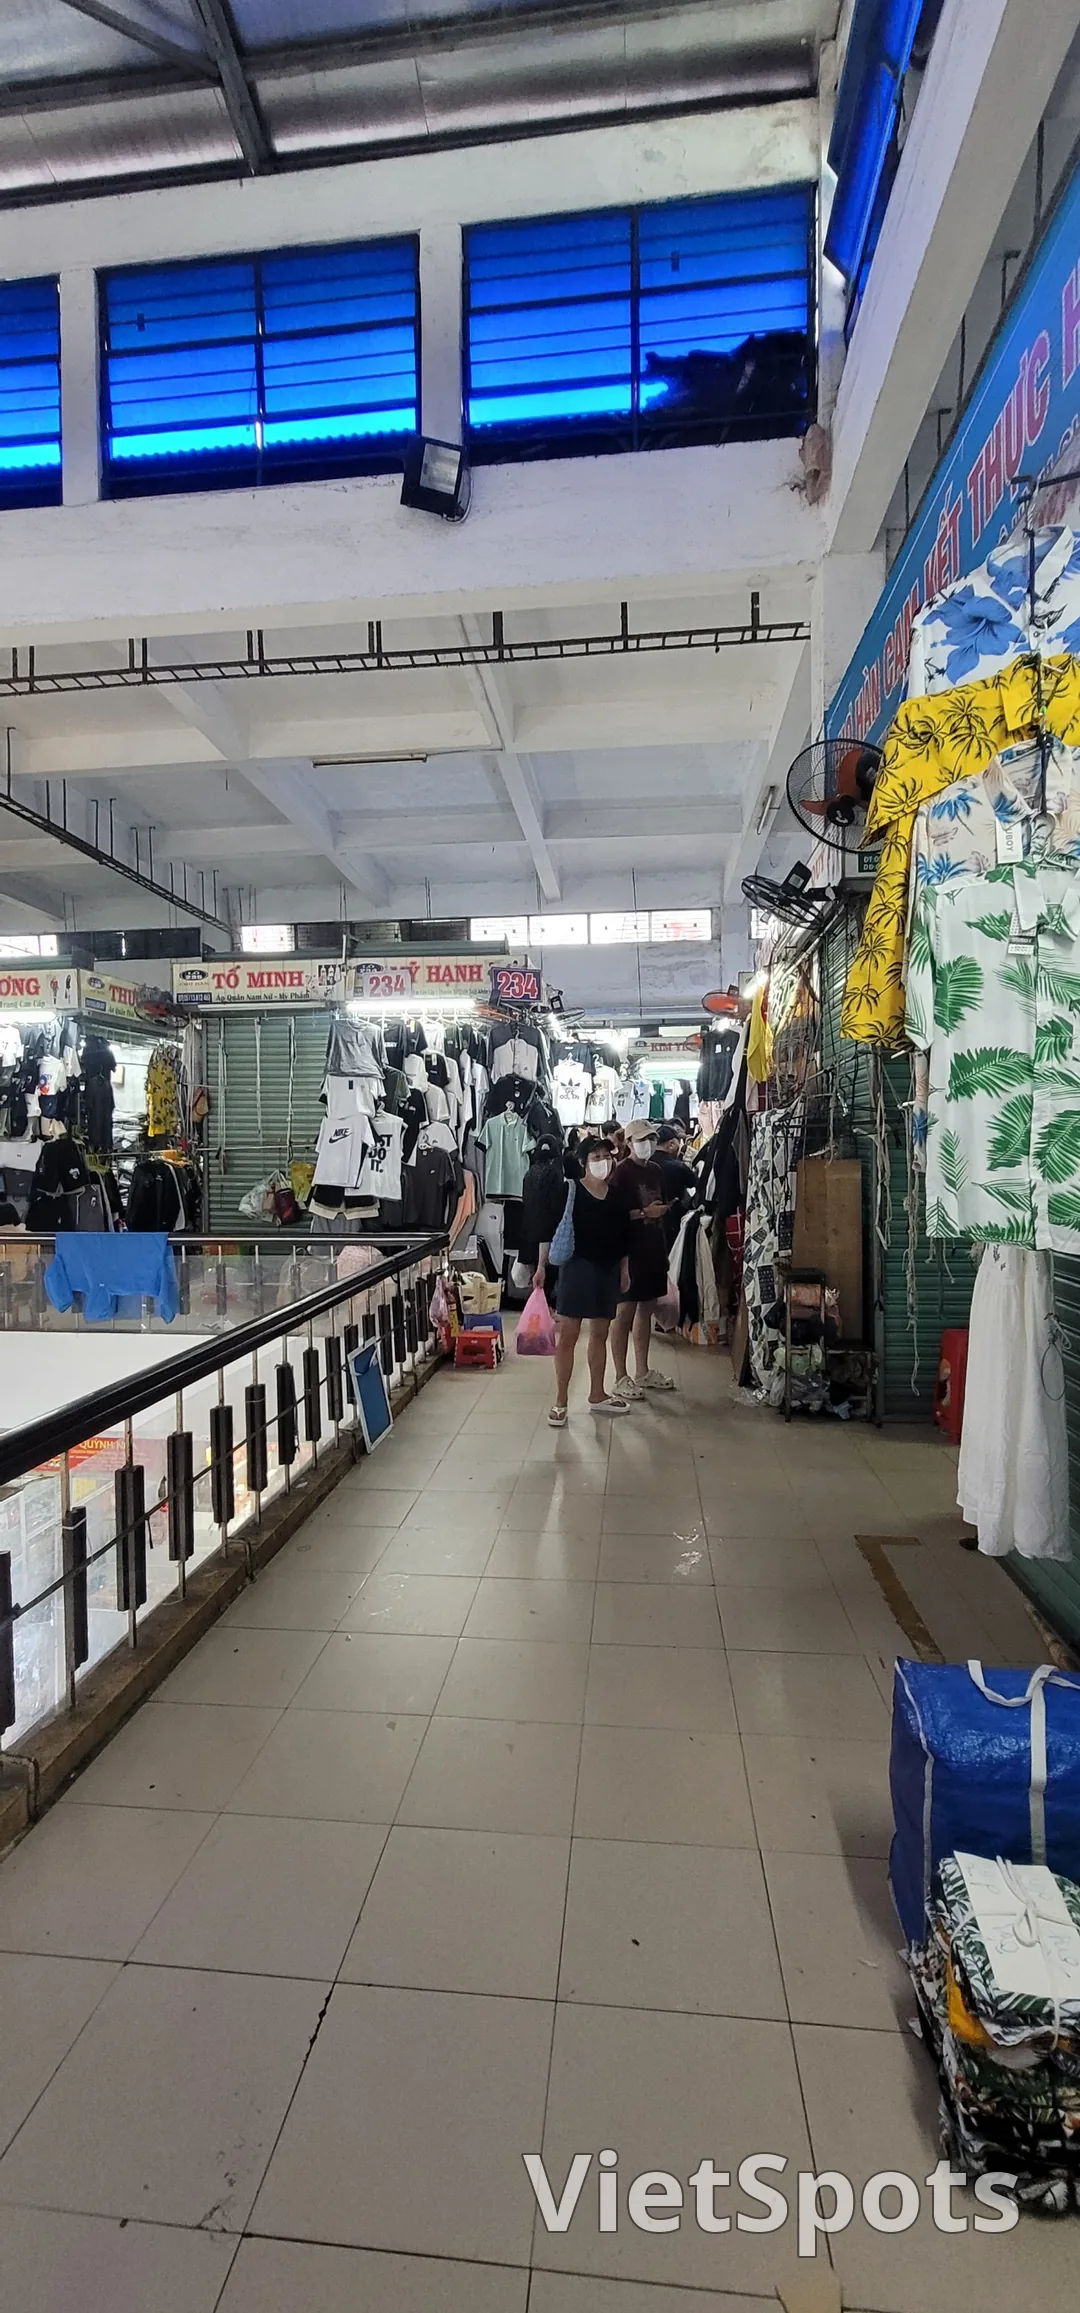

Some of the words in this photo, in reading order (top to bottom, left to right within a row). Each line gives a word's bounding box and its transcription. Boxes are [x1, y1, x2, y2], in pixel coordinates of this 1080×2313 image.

[924, 480, 963, 601] KẾT
[967, 328, 1050, 550] THỰC
[211, 965, 242, 989] TỐ
[247, 970, 305, 989] MINH
[369, 974, 406, 998] 234
[426, 964, 483, 987] HẠNH
[497, 971, 538, 999] 234
[333, 1128, 350, 1137] NIKE
[368, 1147, 387, 1161] DO
[370, 1159, 384, 1173] IT.
